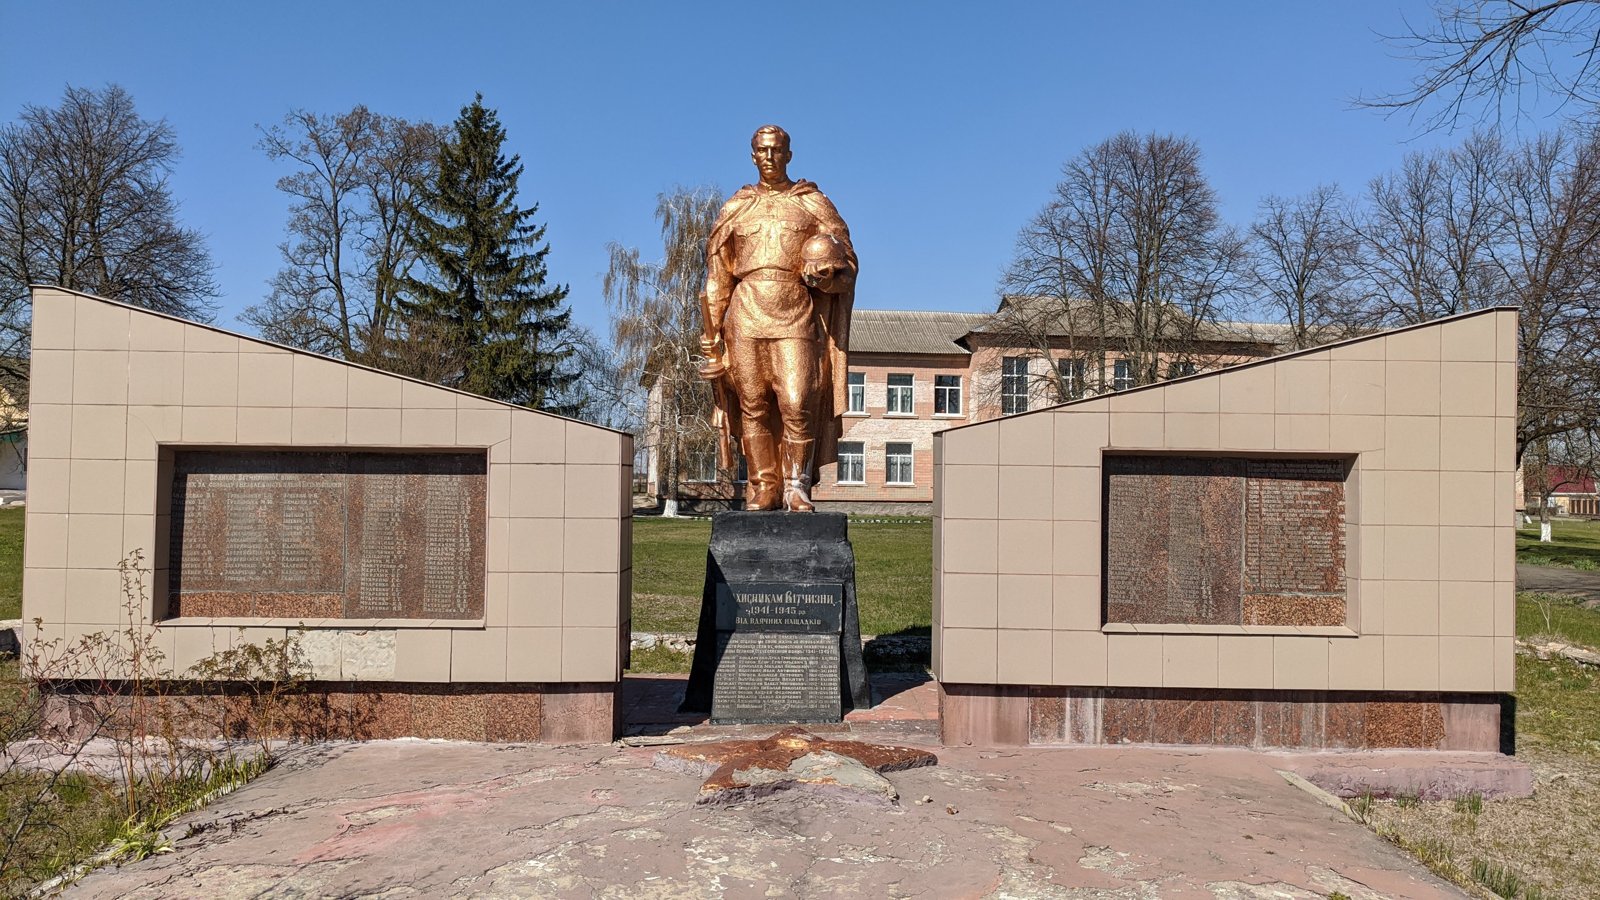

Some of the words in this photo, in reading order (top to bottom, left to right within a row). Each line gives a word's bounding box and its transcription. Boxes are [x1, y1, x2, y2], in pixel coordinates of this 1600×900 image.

[734, 593, 783, 604] ХИСНИКАМ
[736, 617, 748, 625] ВІД
[750, 617, 782, 625] ВДЯЧНИХ
